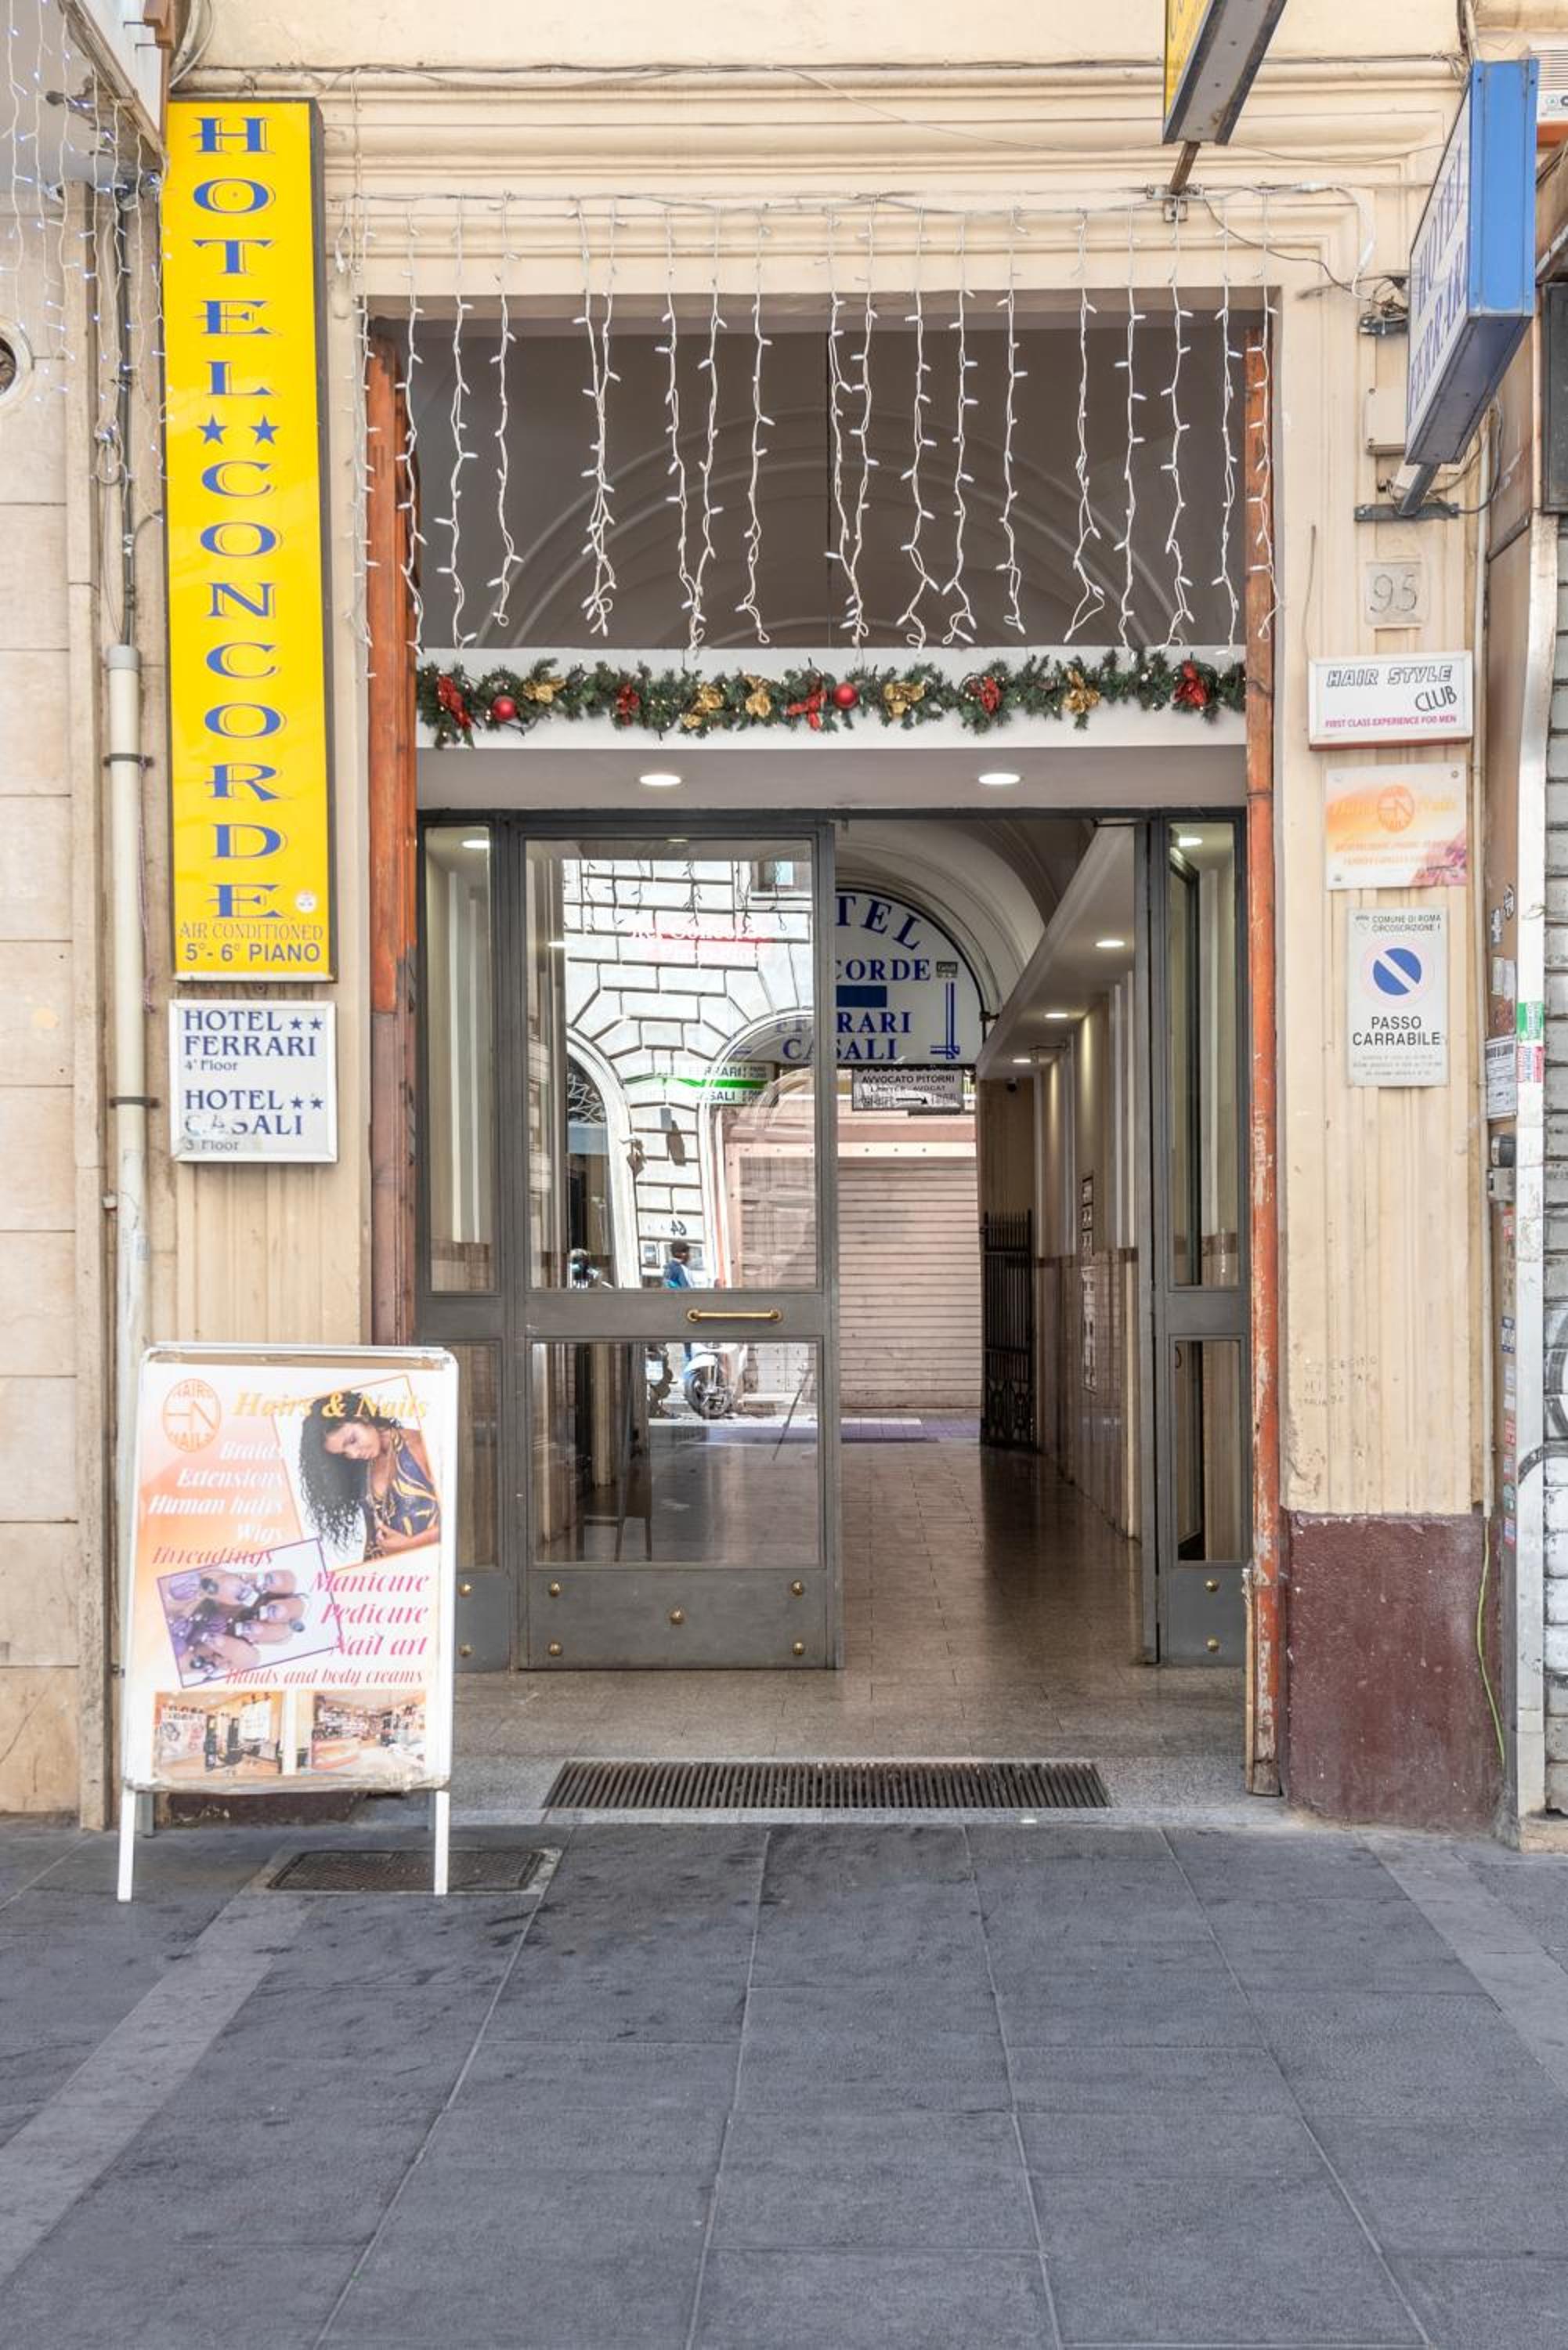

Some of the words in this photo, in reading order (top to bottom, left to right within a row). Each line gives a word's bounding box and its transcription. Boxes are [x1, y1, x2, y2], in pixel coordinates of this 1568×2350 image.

[188, 116, 282, 398] HOTEL
[1369, 573, 1418, 613] 95
[1326, 670, 1379, 688] HAIR
[1388, 664, 1453, 685] STYLE
[199, 461, 296, 920] CONCORDE
[1414, 685, 1458, 712] CLUB
[1325, 719, 1346, 728] FIRST
[1347, 718, 1371, 728] CLASS
[1371, 716, 1419, 727] EXPERIENCE
[1422, 715, 1438, 725] FOR
[1440, 714, 1458, 724] MEN
[1372, 915, 1406, 924] COMUNE
[1418, 914, 1442, 923] ROMA
[1372, 924, 1434, 933] CIRCOSCRIZIONE
[181, 922, 208, 939] AIR
[212, 923, 323, 941] CONDITIONED
[249, 943, 321, 963] PIANO
[184, 1010, 283, 1032] HOTEL
[1371, 1015, 1422, 1030] PASSO
[185, 1036, 316, 1058] FERRARI
[1352, 1032, 1441, 1047] CARRABILE
[201, 1060, 239, 1072] Floor
[862, 1075, 914, 1084] AVVOCATO
[916, 1074, 956, 1083] PITORRI
[185, 1090, 284, 1110] HOTEL
[201, 1141, 240, 1152] Floor
[320, 1394, 346, 1418] &
[176, 1467, 284, 1488] Extensions
[148, 1495, 226, 1517] Human
[313, 1571, 429, 1593] Manicure
[320, 1603, 429, 1625] Pedicure
[332, 1636, 382, 1656] Nail
[390, 1636, 428, 1656] art
[226, 1668, 278, 1684] Hands
[284, 1668, 317, 1684] and
[322, 1668, 361, 1687] body
[367, 1668, 423, 1683] creams
